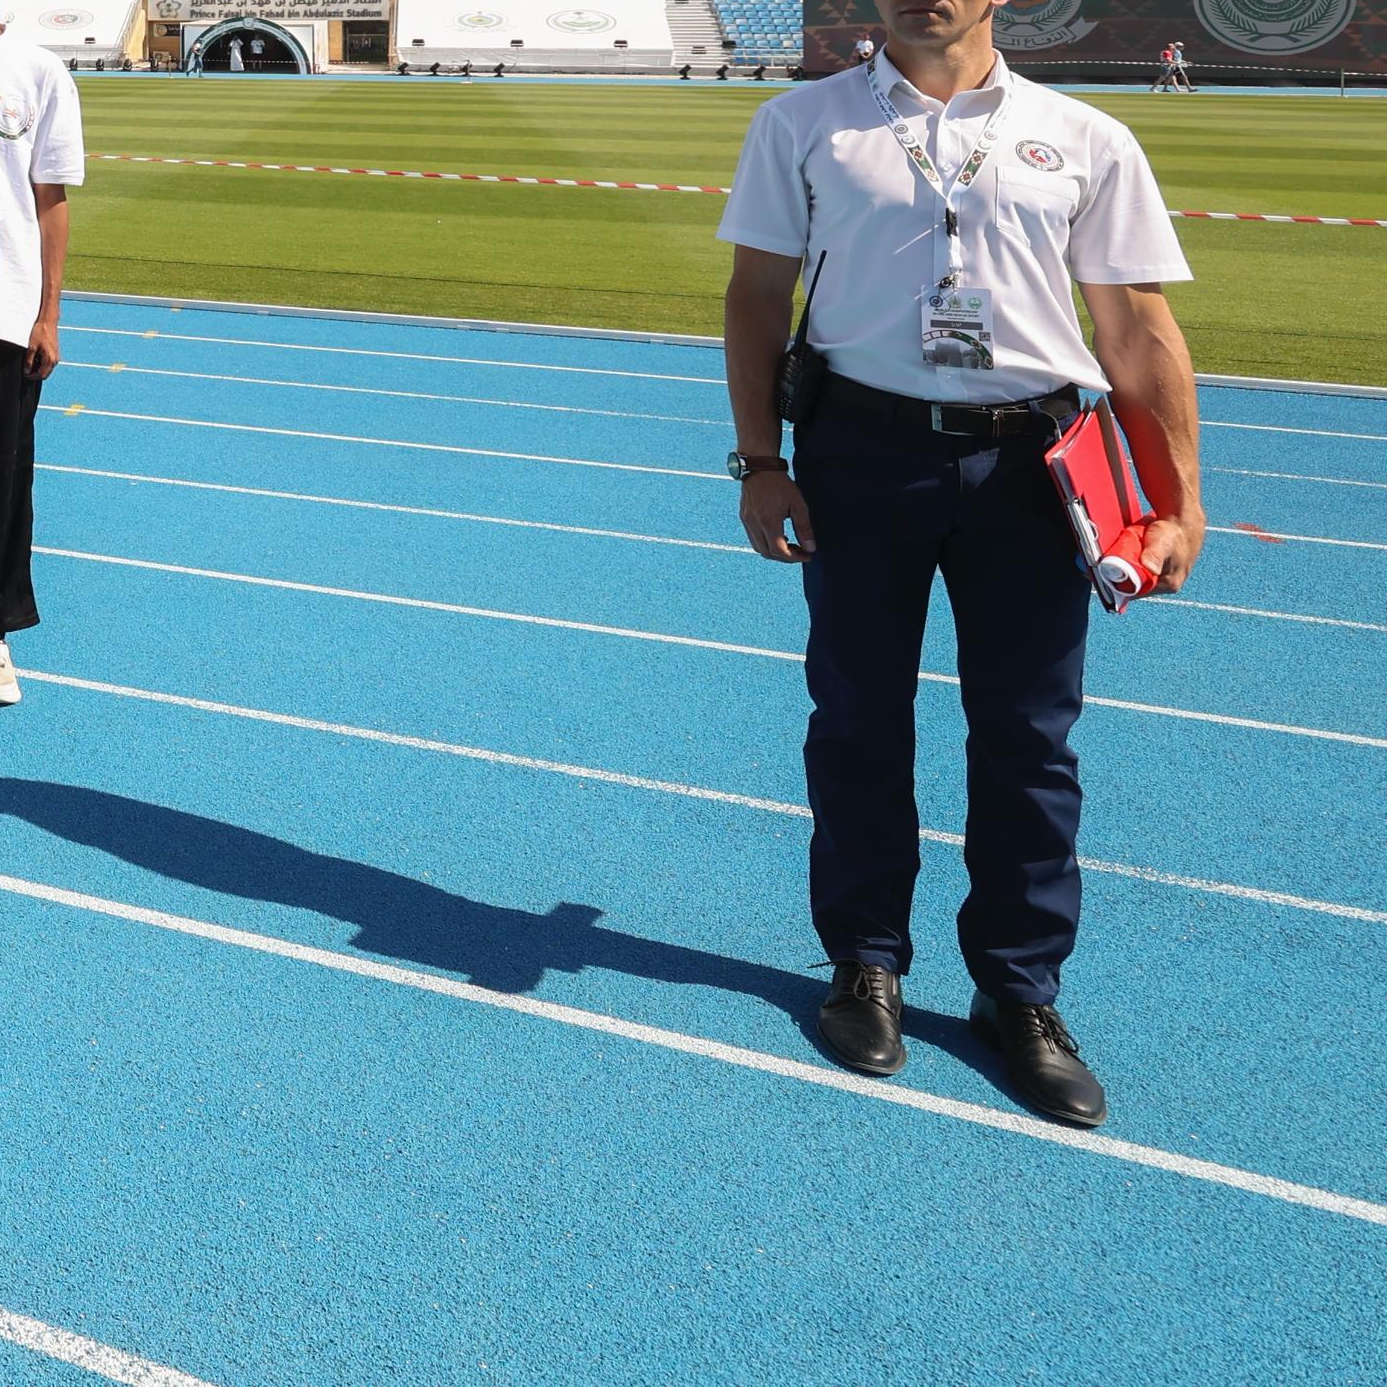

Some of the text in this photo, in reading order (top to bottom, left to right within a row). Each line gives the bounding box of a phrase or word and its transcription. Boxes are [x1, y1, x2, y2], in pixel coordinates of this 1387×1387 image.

[236, 0, 247, 7] بن
[190, 8, 382, 18] Prince Faisal bin Fahad bin Abdulaziz Stadium
